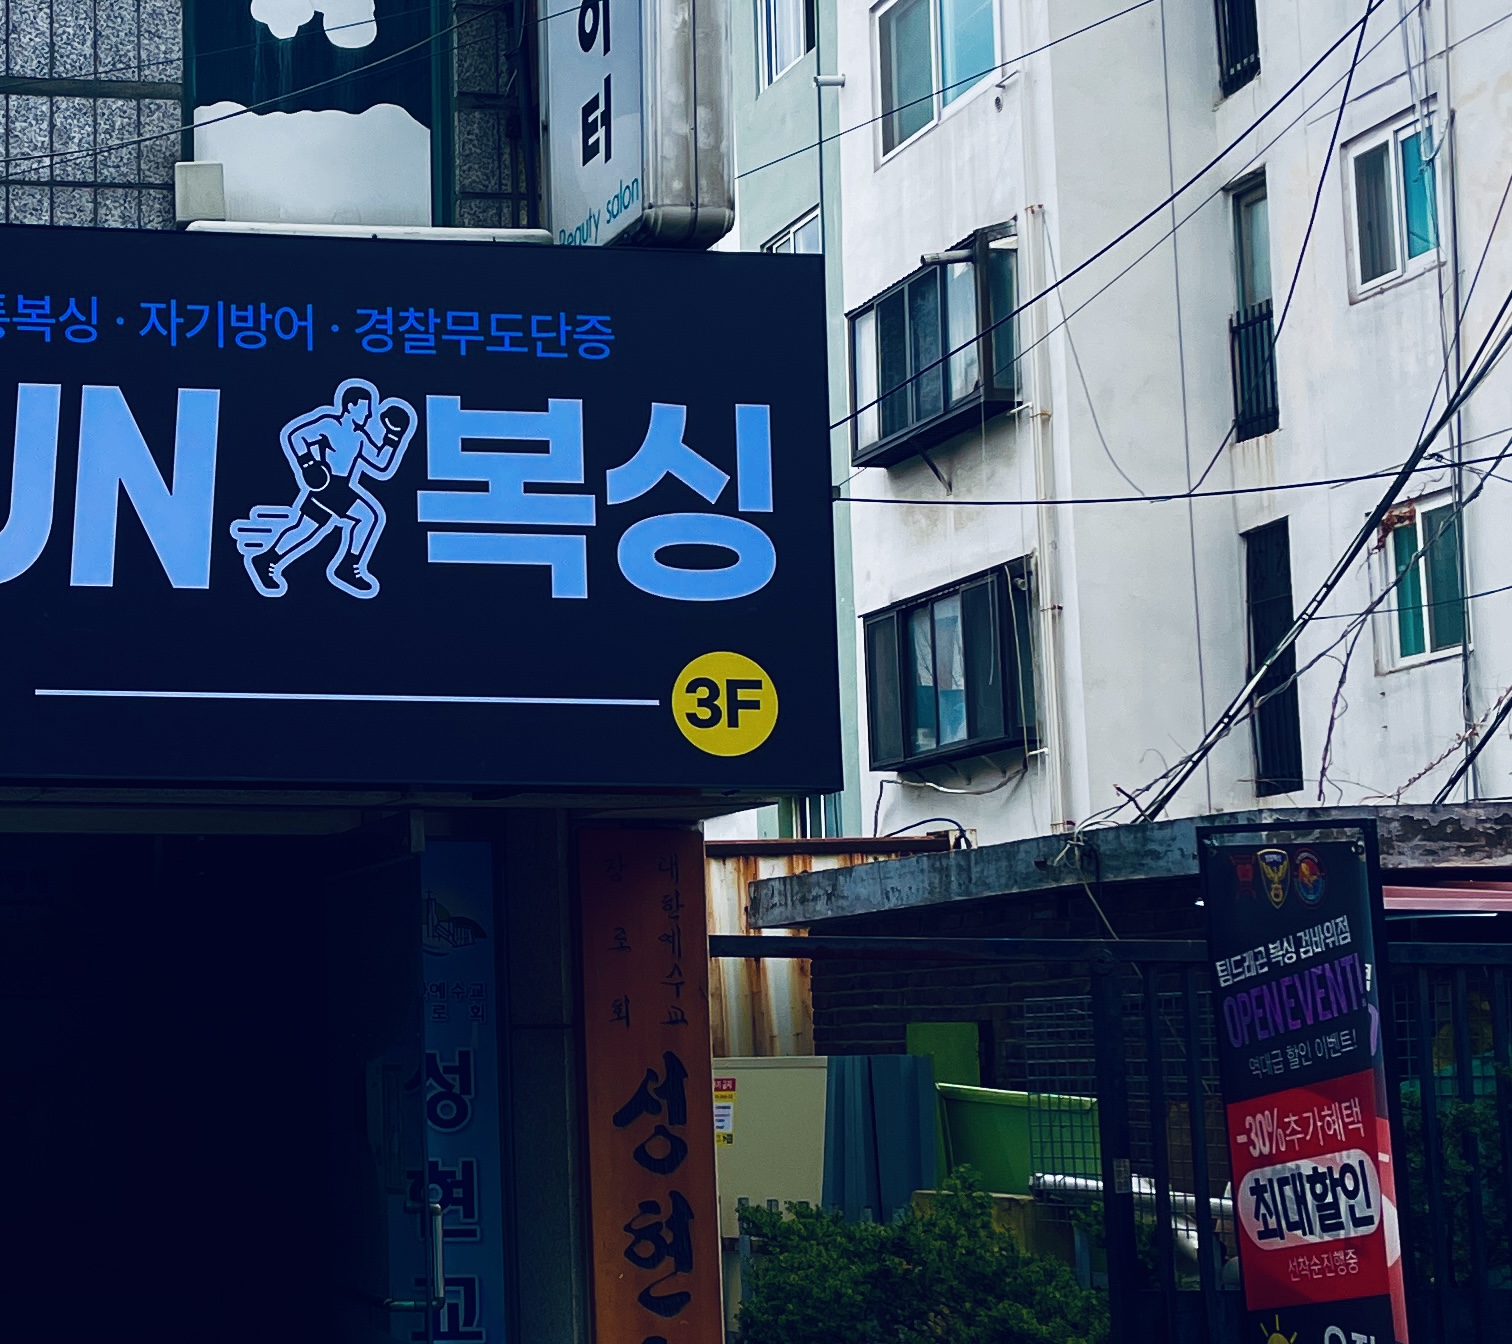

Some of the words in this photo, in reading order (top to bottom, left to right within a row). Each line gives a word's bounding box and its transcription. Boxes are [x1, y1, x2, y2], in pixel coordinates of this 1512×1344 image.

[606, 177, 639, 224] salon
[138, 298, 314, 352] 자기방어
[355, 305, 616, 360] 경찰무도단증
[417, 394, 777, 601] 복싱
[684, 678, 763, 729] 3F
[1268, 934, 1297, 968] 복싱
[1297, 914, 1353, 961] 검바위점
[1249, 1159, 1376, 1241] 최대할인
